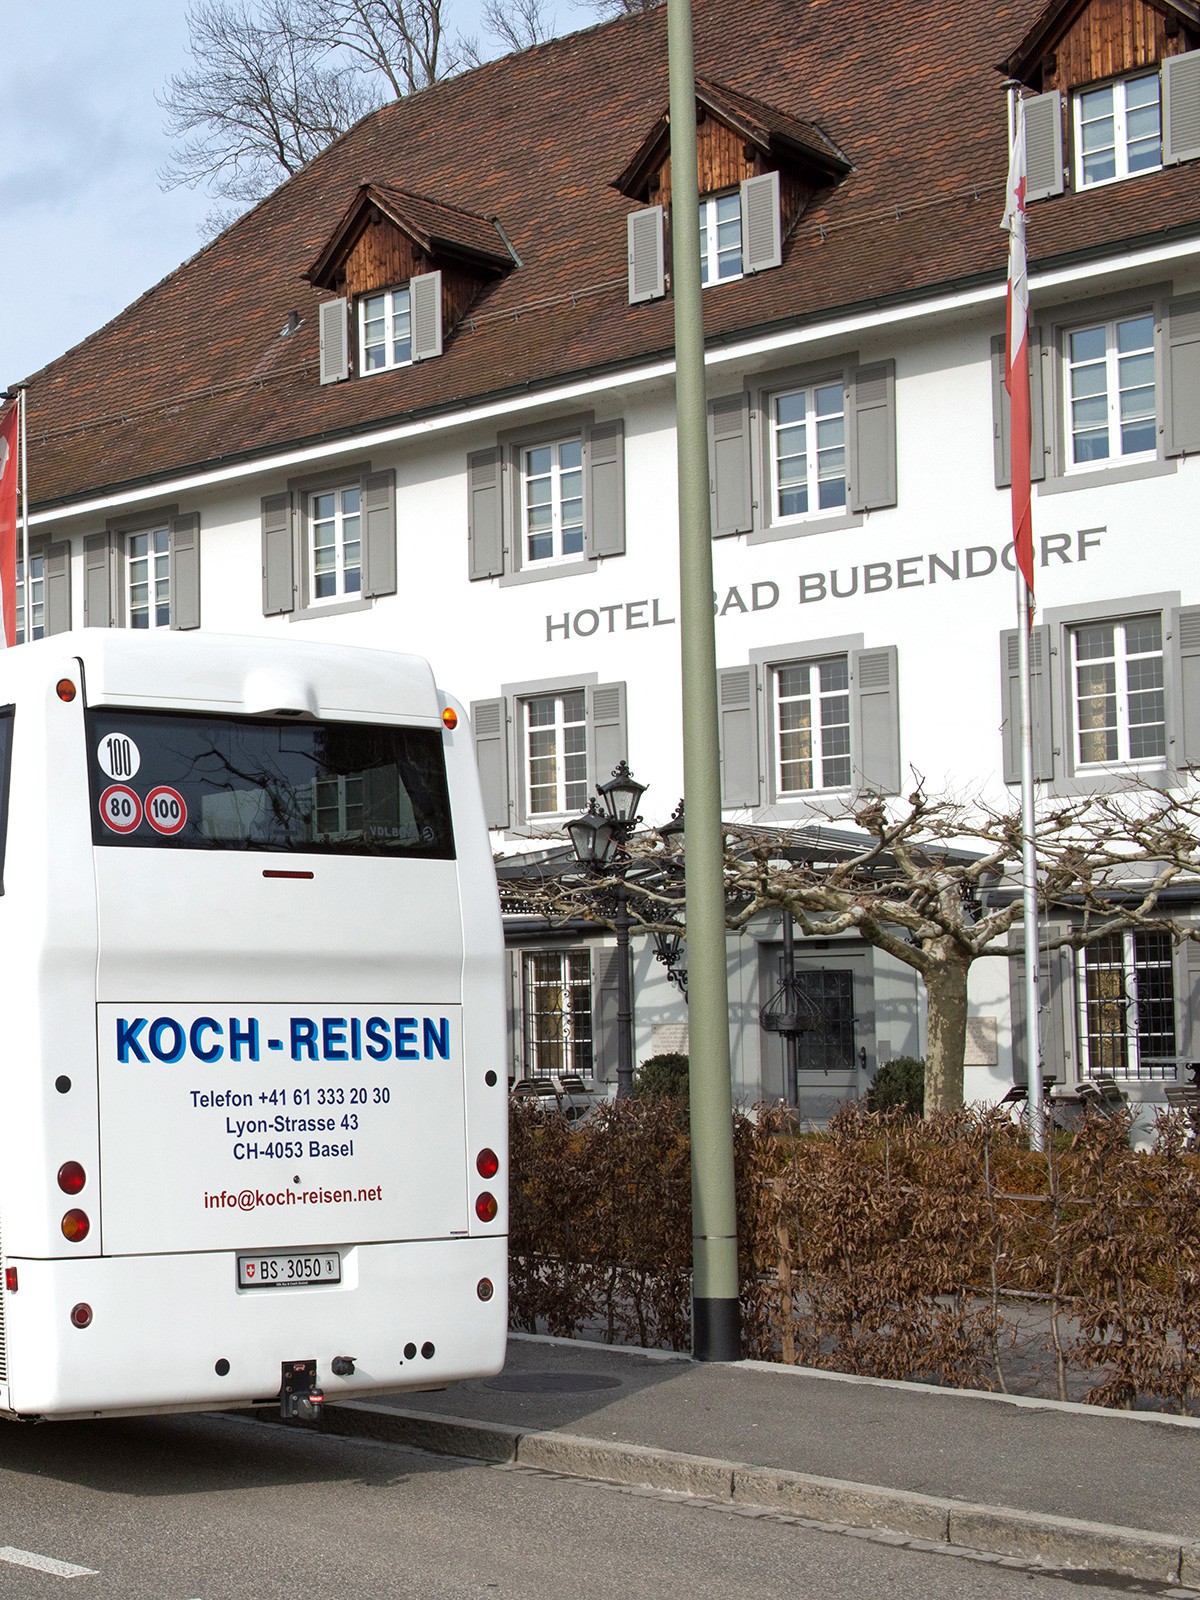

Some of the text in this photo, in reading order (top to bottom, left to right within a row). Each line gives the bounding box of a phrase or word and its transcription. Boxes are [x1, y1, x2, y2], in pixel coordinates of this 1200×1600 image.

[546, 598, 676, 642] HOTEL
[713, 581, 780, 616] AD
[106, 738, 132, 777] 100
[111, 798, 132, 818] 80
[153, 798, 180, 819] 100
[189, 1087, 391, 1108] Telefon +41 61 333 20 30
[226, 1114, 359, 1138] Lyon-Strasse 43
[233, 1140, 354, 1160] CH-4053 Basel
[204, 1185, 383, 1211] info@koch-reisen.net
